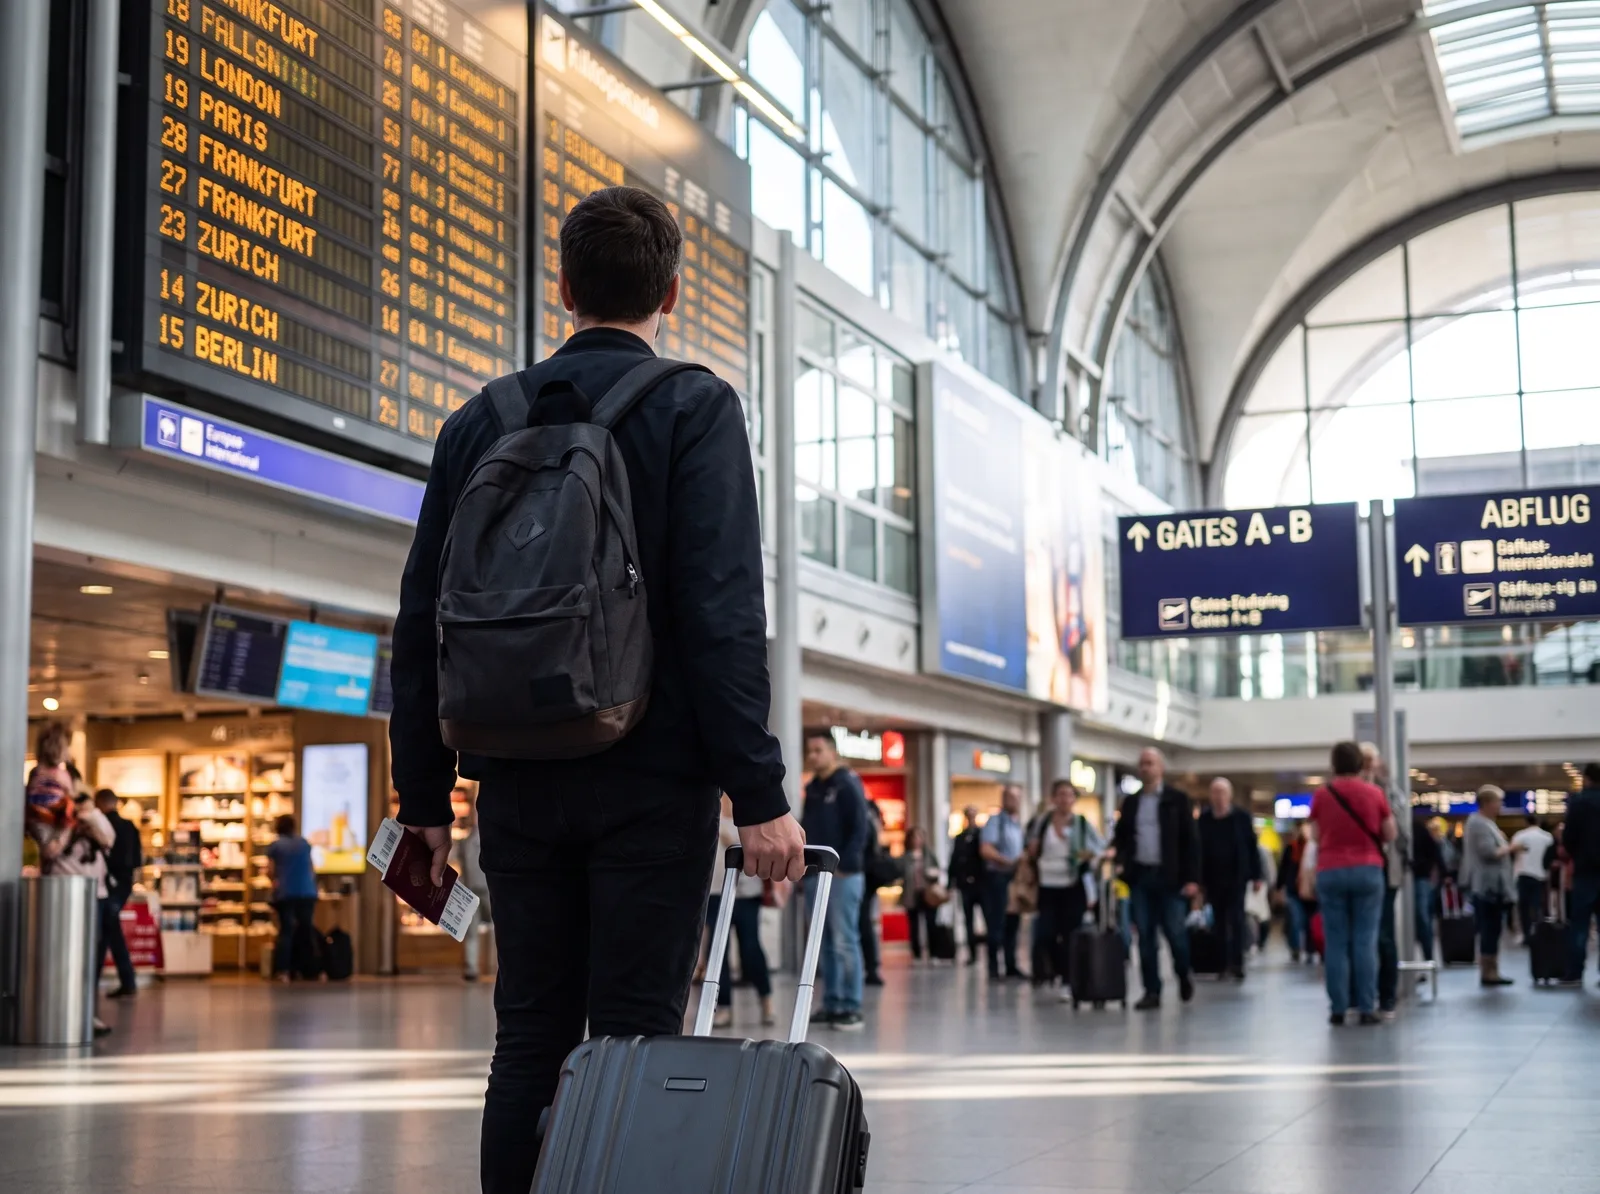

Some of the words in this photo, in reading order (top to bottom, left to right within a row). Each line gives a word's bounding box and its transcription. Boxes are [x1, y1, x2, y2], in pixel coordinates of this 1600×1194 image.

[164, 73, 189, 109] 19
[200, 91, 268, 152] PARIS
[165, 29, 189, 66] 19
[201, 47, 281, 119] LONDON
[161, 115, 188, 153] 28
[199, 133, 318, 217] FRANKFURT
[159, 204, 186, 241] 23
[197, 220, 279, 283] ZURICH
[160, 159, 187, 195] 27
[199, 176, 317, 257] FRANKFURT
[160, 268, 185, 304] 14
[196, 281, 278, 342] ZURICH
[159, 313, 185, 349] 15
[195, 325, 277, 384] BERLIN
[1156, 516, 1238, 551] GATES
[1480, 494, 1591, 529] ABFLUG
